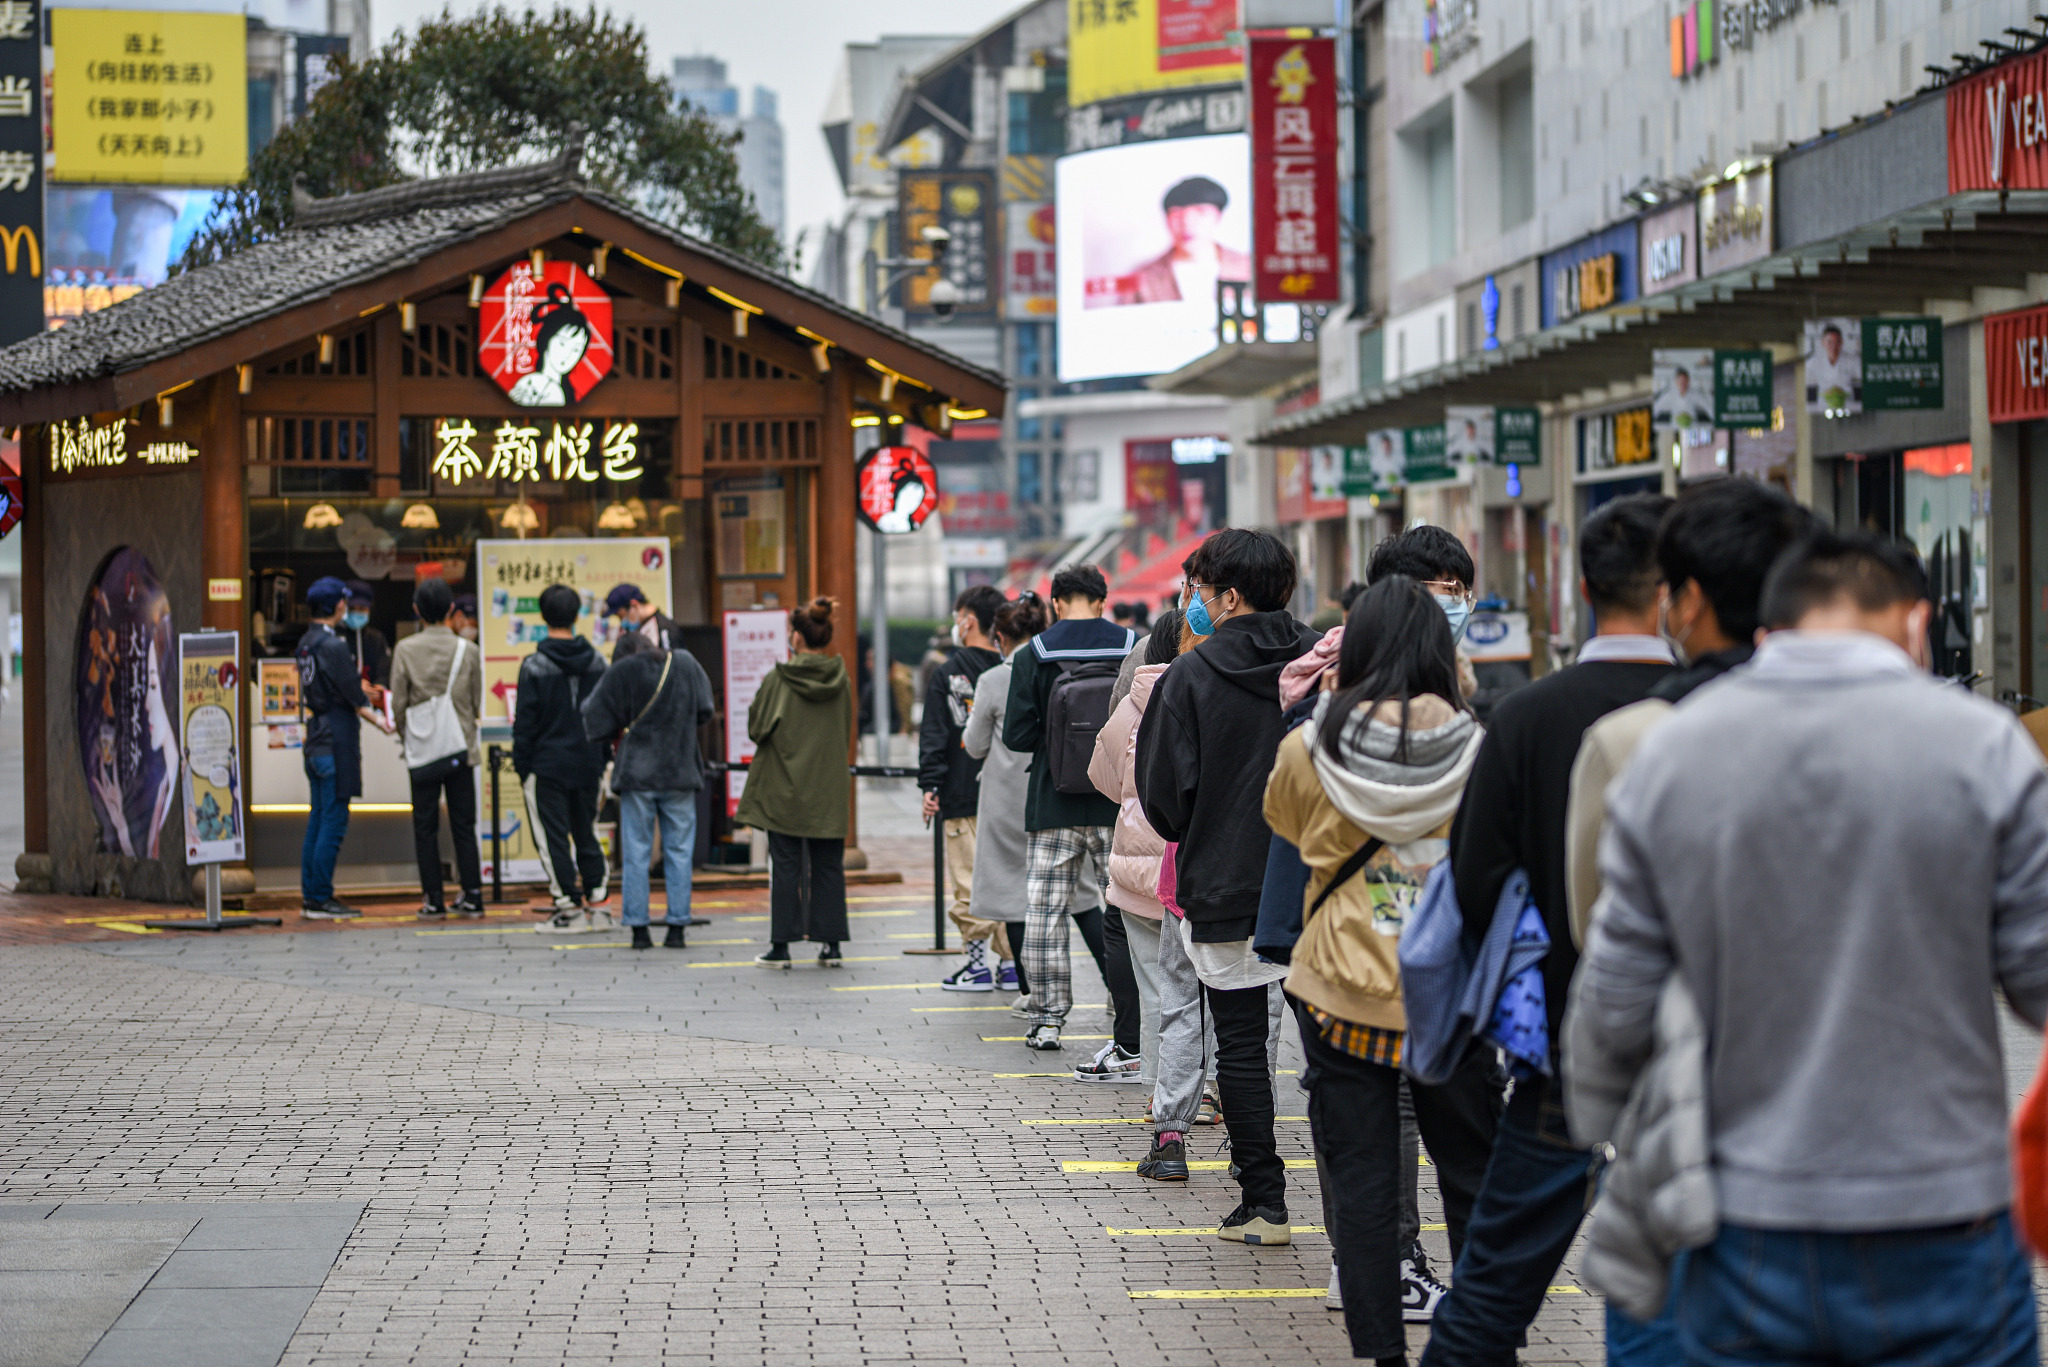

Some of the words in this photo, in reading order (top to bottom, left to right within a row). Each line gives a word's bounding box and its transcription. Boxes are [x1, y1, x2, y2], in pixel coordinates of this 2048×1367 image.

[1274, 106, 1316, 254] 风云再起
[61, 416, 128, 474] 茶颜悦色
[431, 419, 644, 486] 茶颜悦色
